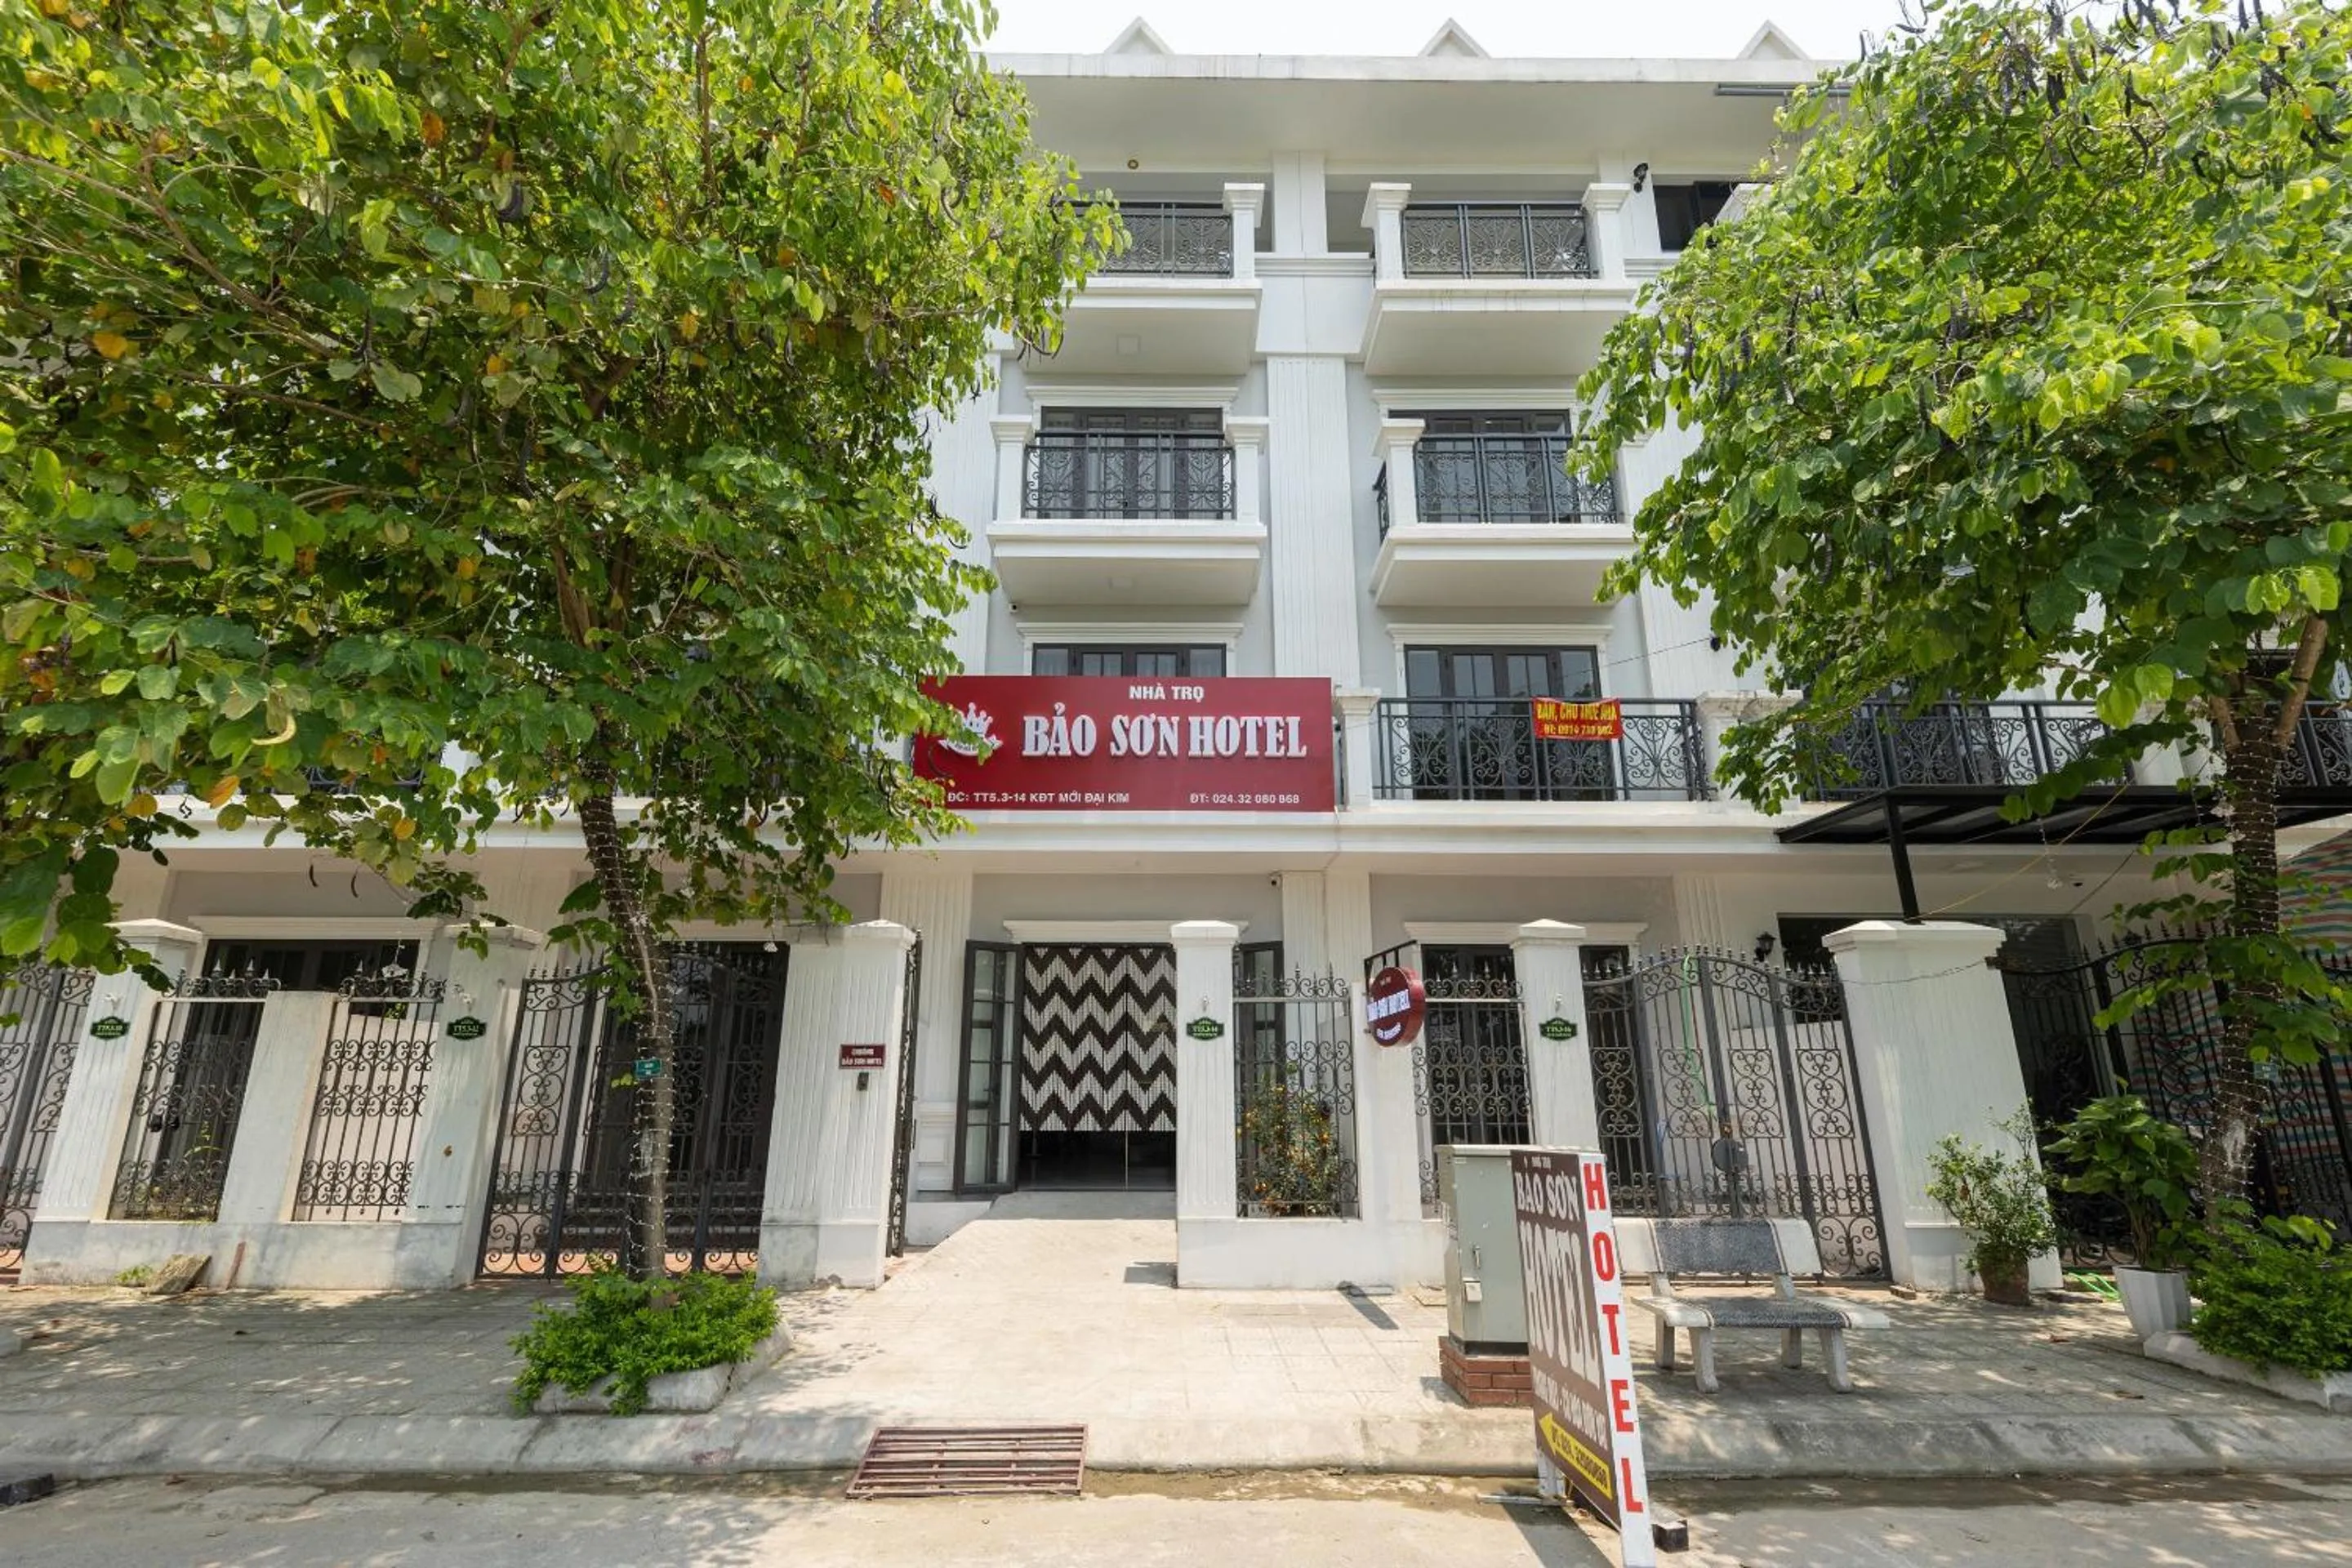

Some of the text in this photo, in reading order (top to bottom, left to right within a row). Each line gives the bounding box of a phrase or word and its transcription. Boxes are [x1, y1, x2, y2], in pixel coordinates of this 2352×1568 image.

[1129, 683, 1205, 703] NHÀ TRỌ
[1022, 702, 1307, 758] BẢO SƠN HOTEL
[947, 790, 1129, 806] ĐC: TT5.3-14 KĐT MỚI ĐẠI KIM
[1189, 793, 1209, 804] ĐT:
[1254, 794, 1276, 804] 080
[1279, 794, 1299, 804] 868
[1545, 1170, 1580, 1223] SƠN
[1520, 1219, 1601, 1391] HOTEL
[1583, 1162, 1644, 1513] HOTEL
